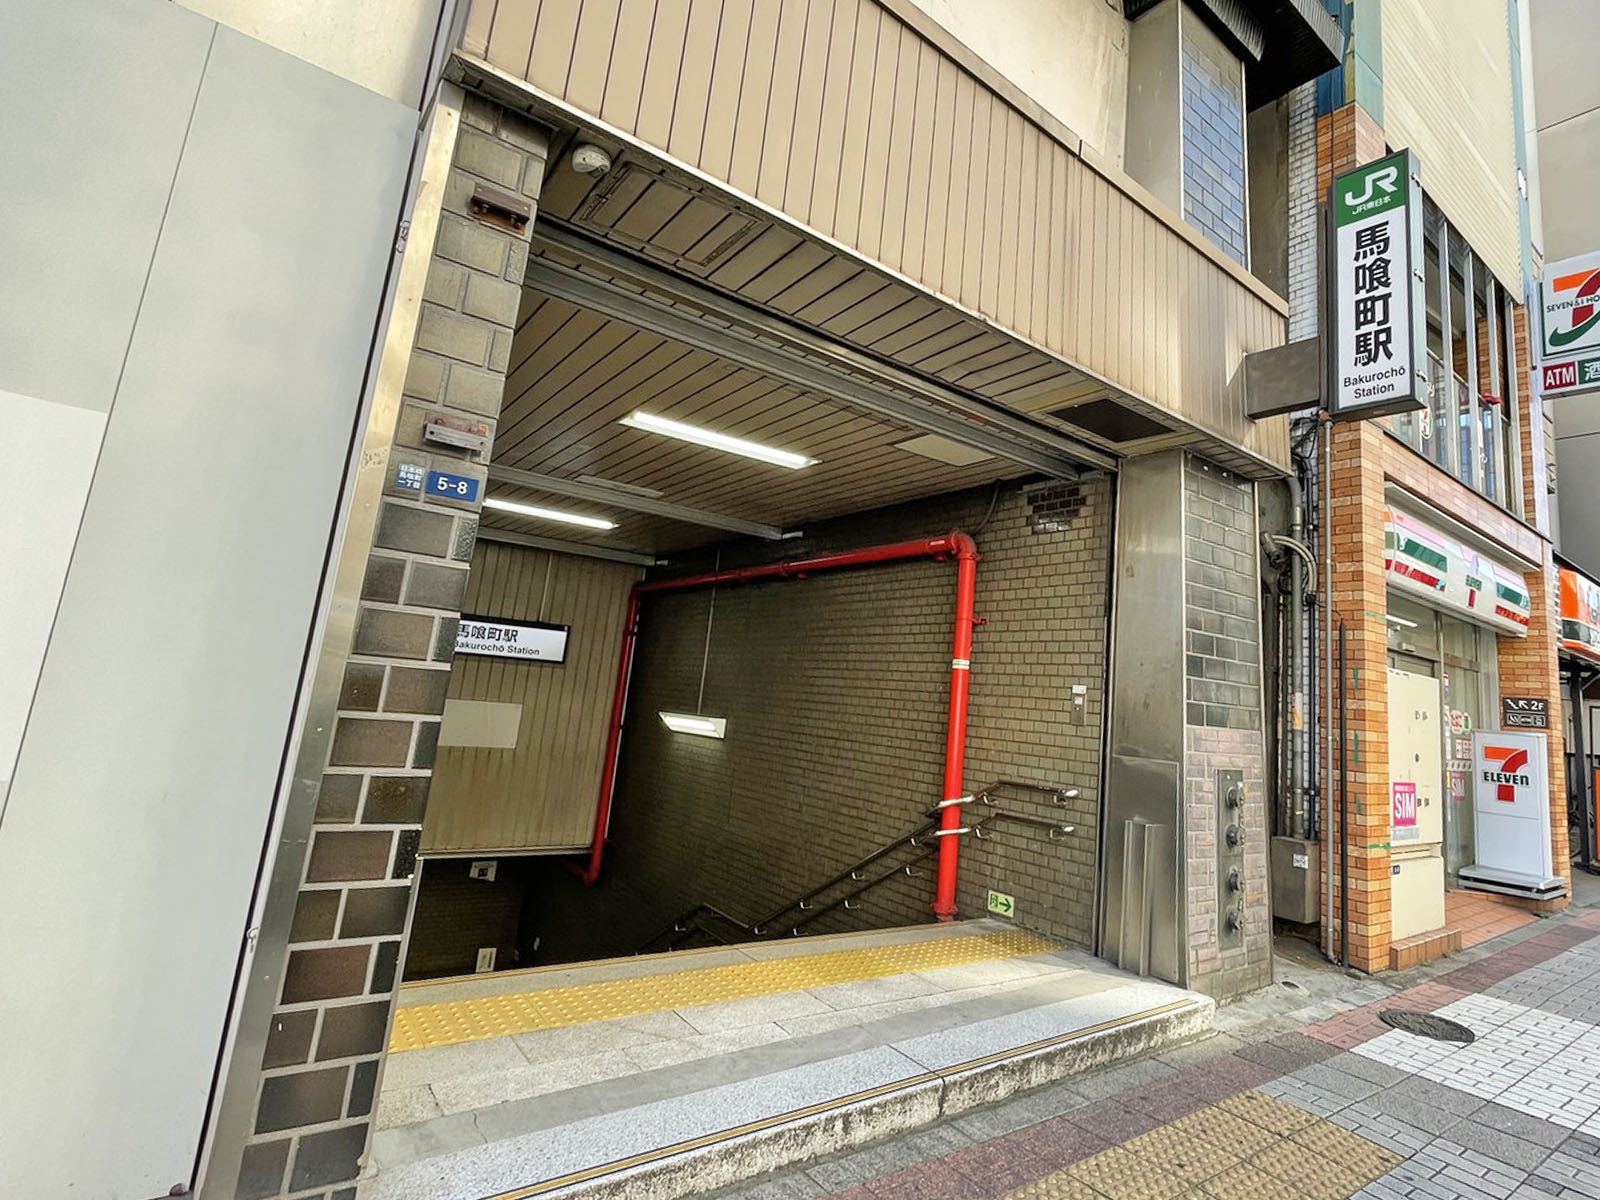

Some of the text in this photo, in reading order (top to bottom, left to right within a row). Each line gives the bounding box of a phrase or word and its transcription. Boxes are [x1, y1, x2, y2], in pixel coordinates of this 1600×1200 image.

[1345, 166, 1398, 206] JR
[1352, 195, 1391, 215] JR東日本
[1354, 220, 1393, 366] 馬喰町駅
[1546, 366, 1575, 387] ATM
[1354, 383, 1395, 399] Station
[437, 477, 468, 494] 5-8
[458, 624, 518, 643] 馬喰町駅
[507, 645, 540, 656] Station
[1531, 701, 1544, 710] 2F
[1394, 793, 1415, 818] SIM
